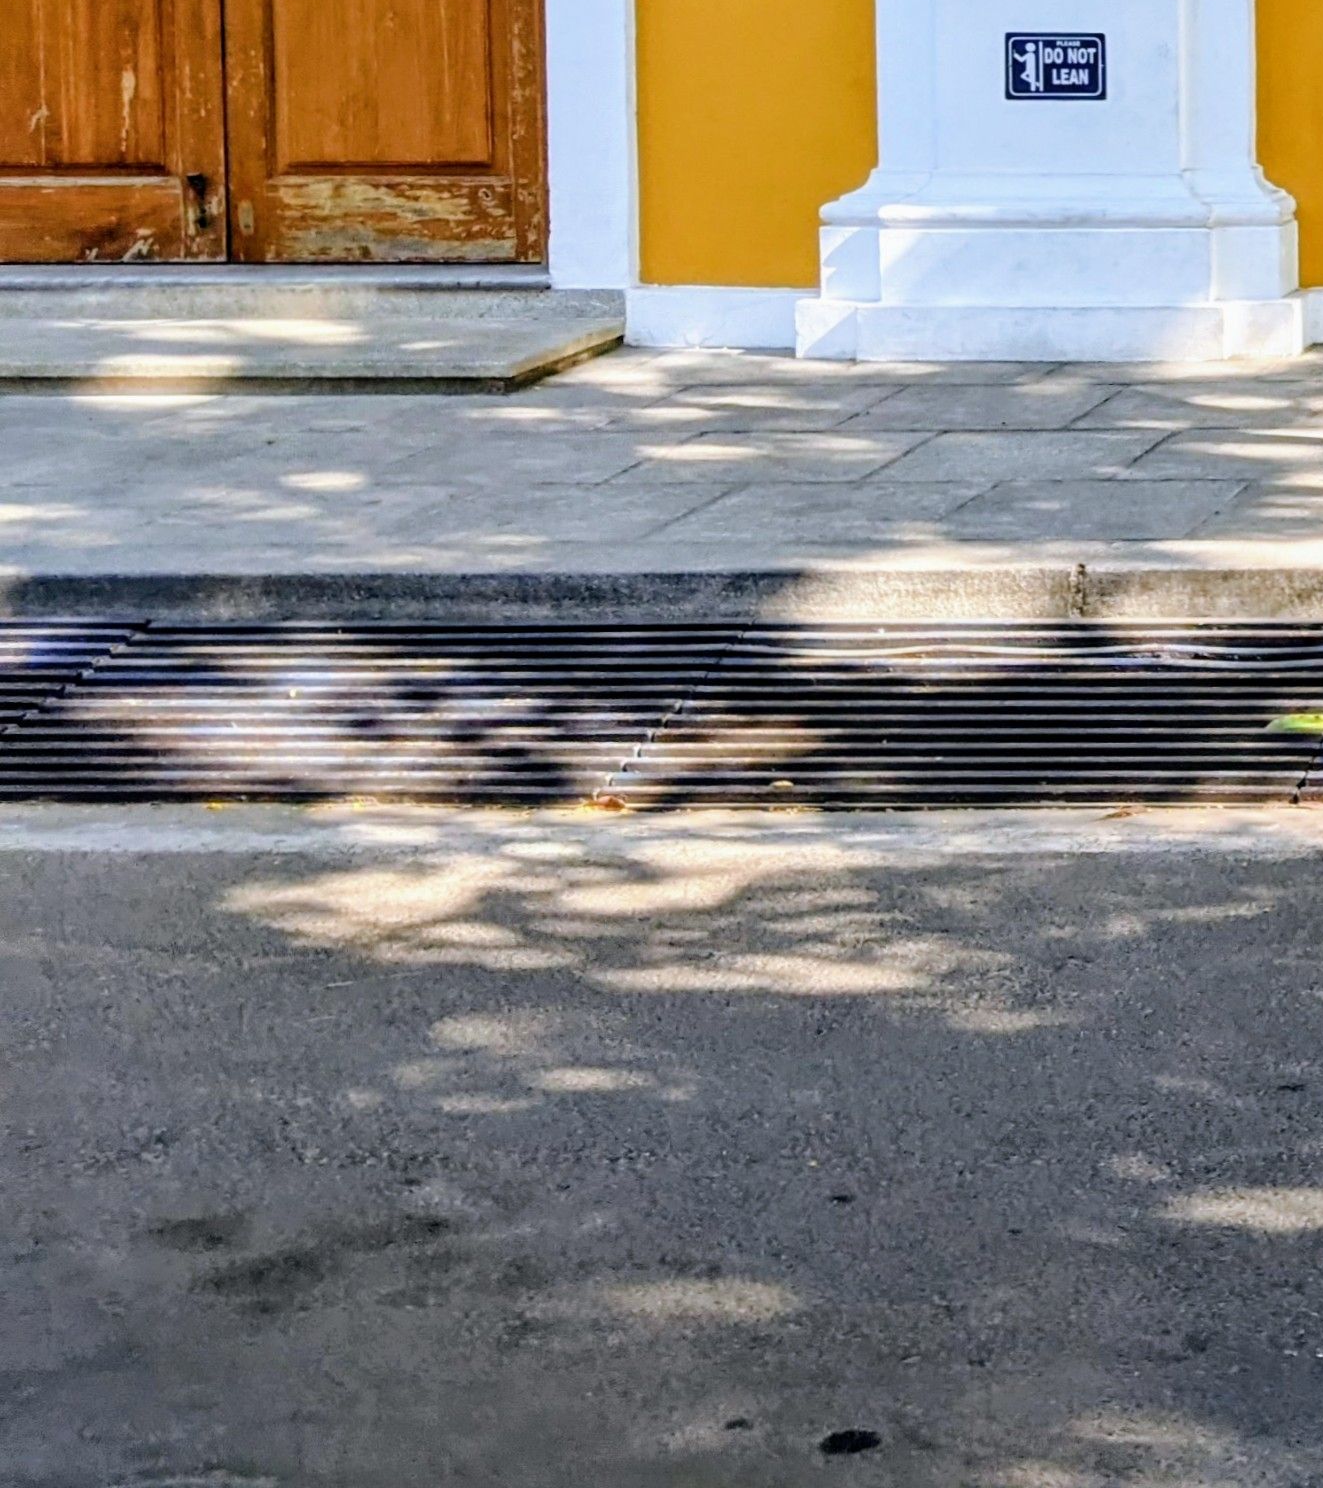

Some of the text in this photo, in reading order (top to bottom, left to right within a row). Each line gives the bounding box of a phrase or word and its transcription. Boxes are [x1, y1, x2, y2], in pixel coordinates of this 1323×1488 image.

[1044, 47, 1097, 64] DO NOT
[1052, 68, 1089, 85] LEAN
